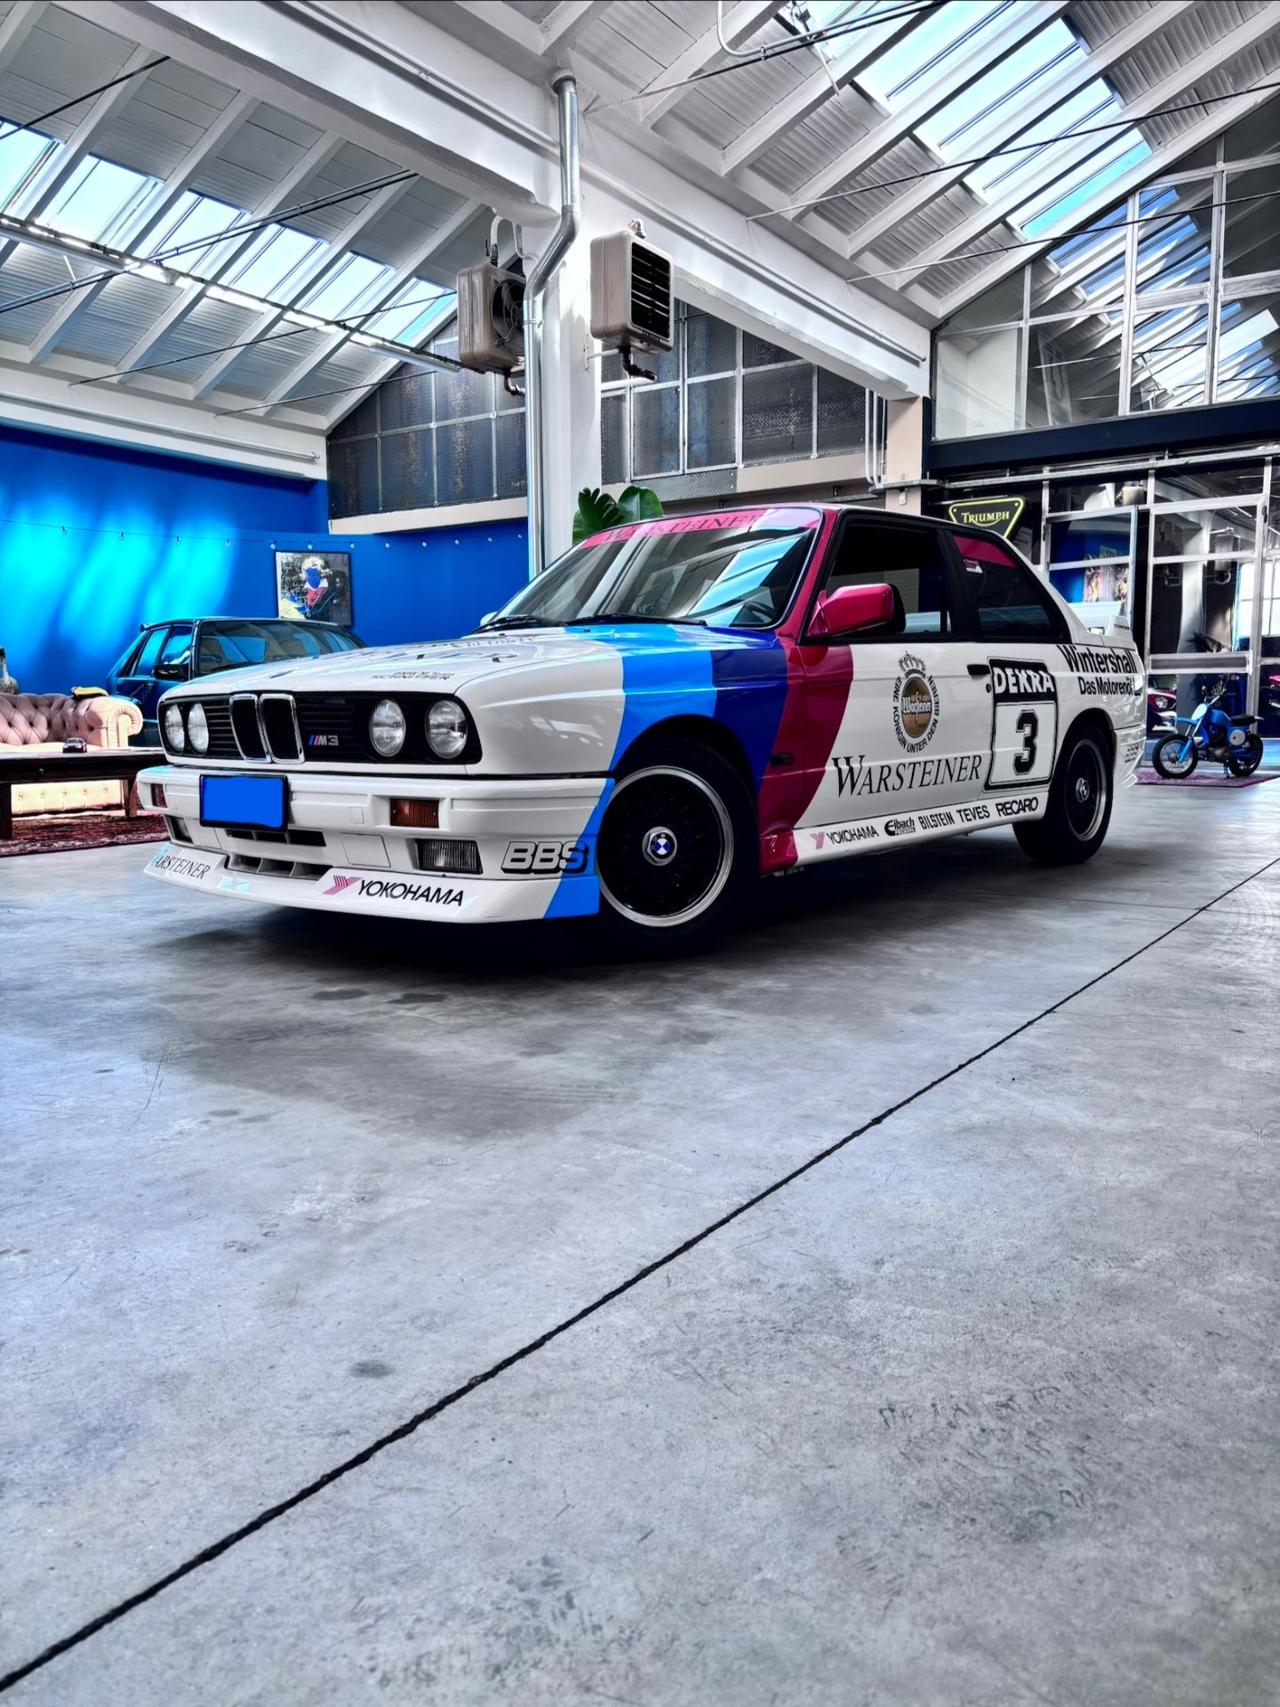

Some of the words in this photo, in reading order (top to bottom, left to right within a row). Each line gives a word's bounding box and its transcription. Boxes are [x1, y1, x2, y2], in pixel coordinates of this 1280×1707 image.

[961, 511, 1010, 523] TRIUMPH
[1057, 644, 1138, 674] Wintershall
[992, 667, 1055, 694] DEKRA
[1077, 676, 1096, 695] Das
[906, 738, 928, 753] UNTER
[927, 718, 938, 741] DEN
[1013, 709, 1039, 776] 3
[832, 755, 982, 798] WARSTEINER
[826, 825, 879, 844] YOKOHAMA
[918, 811, 955, 830] BILSTEIN
[956, 804, 990, 823] TEVES
[995, 797, 1039, 817] RECARO
[501, 841, 589, 874] BBS
[358, 880, 464, 906] YOKOHAMA
